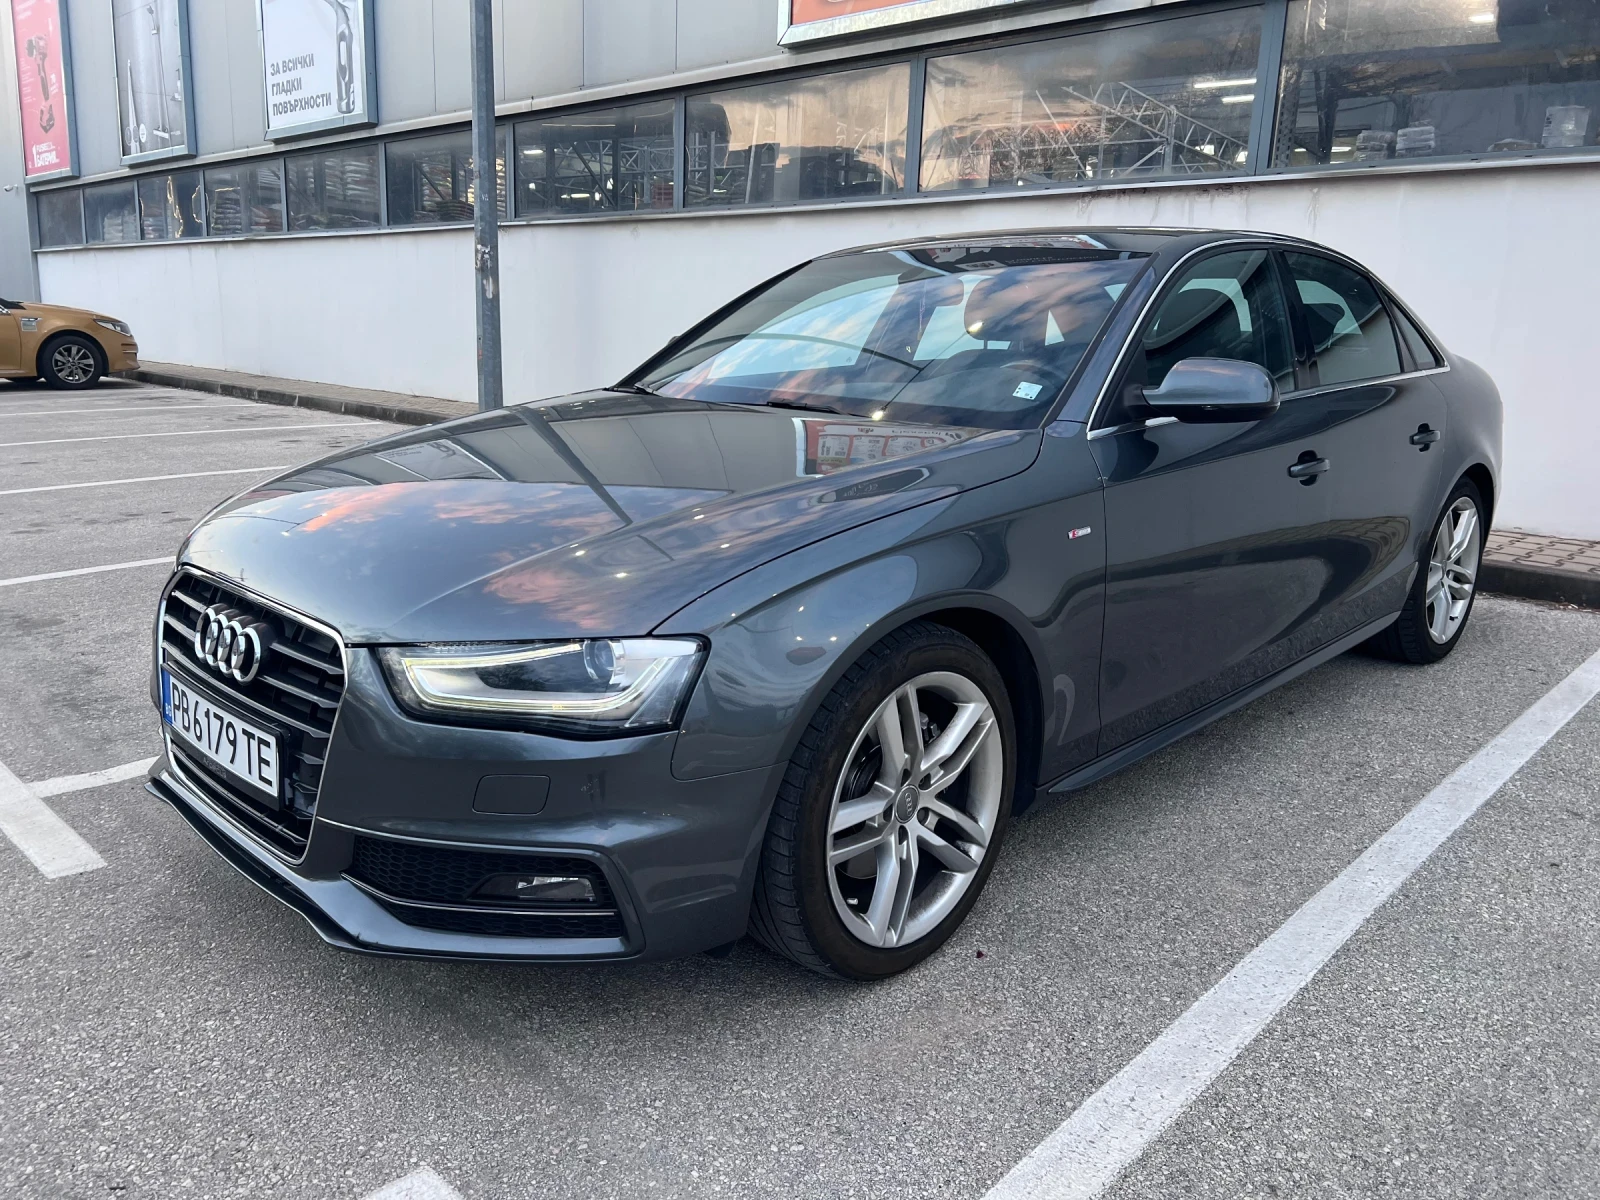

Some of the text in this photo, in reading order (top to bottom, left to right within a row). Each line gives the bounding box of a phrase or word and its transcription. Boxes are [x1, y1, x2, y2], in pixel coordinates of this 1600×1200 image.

[270, 53, 314, 76] ЗА ВСИЧКИ
[271, 77, 302, 96] ГЛАДКИ
[272, 92, 332, 116] ПОВЪРХНОСТИ
[172, 681, 273, 787] PB 6179 TE
